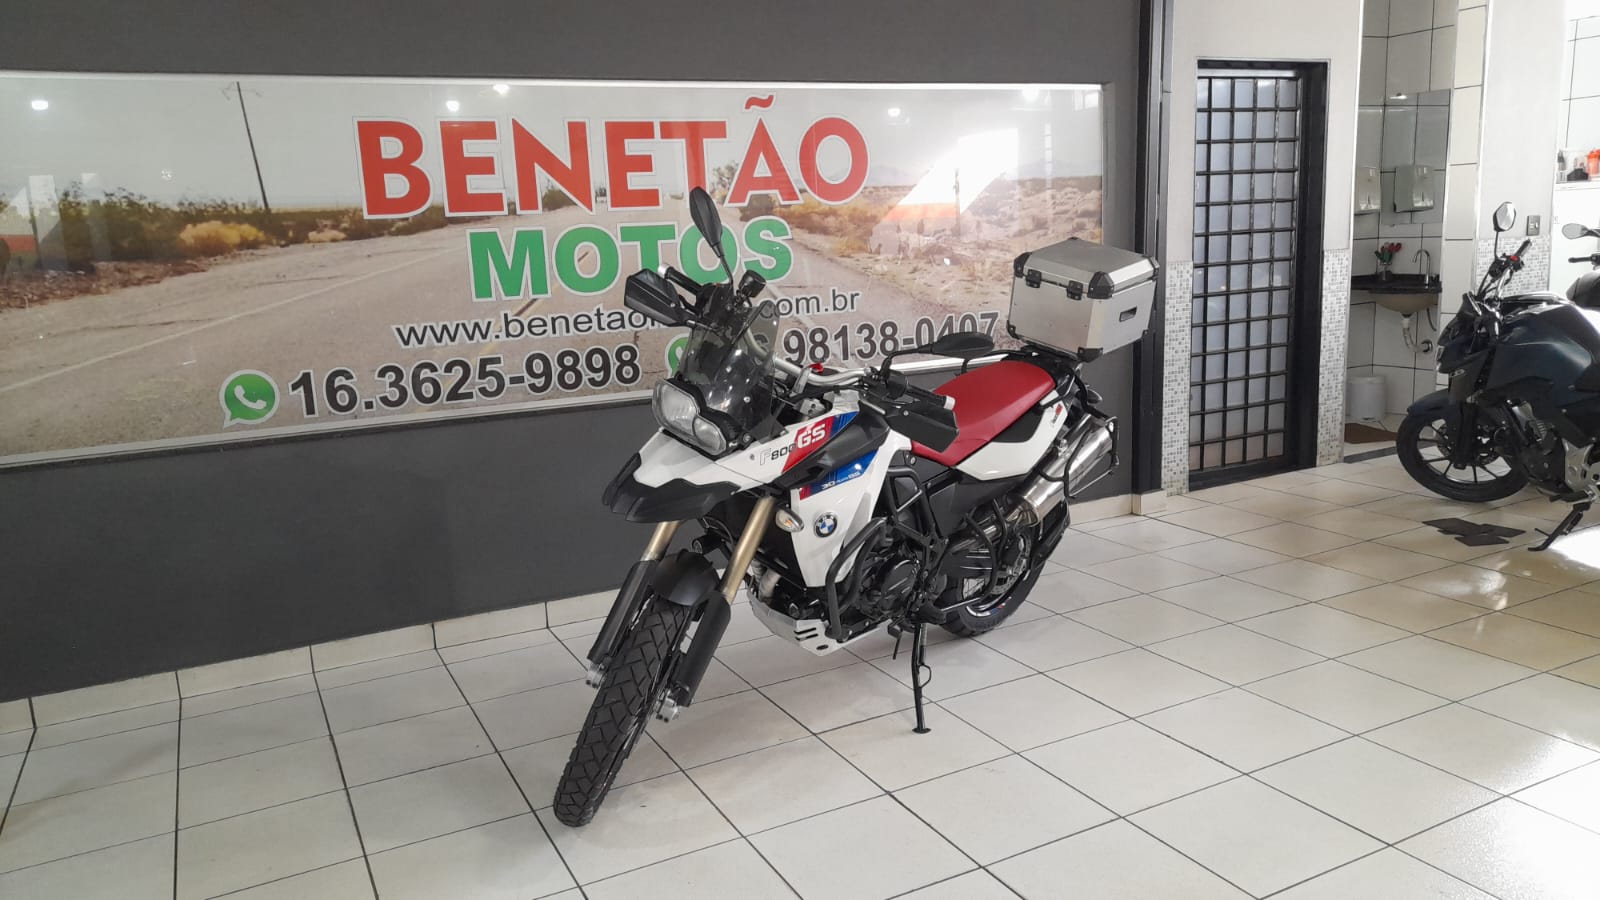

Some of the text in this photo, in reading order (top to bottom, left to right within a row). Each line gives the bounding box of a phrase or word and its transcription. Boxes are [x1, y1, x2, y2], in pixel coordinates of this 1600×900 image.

[356, 94, 869, 217] BENETÃO
[469, 217, 794, 299] MOTOS
[752, 312, 999, 368] 98138-0407
[289, 345, 641, 417] 16.3625-9898
